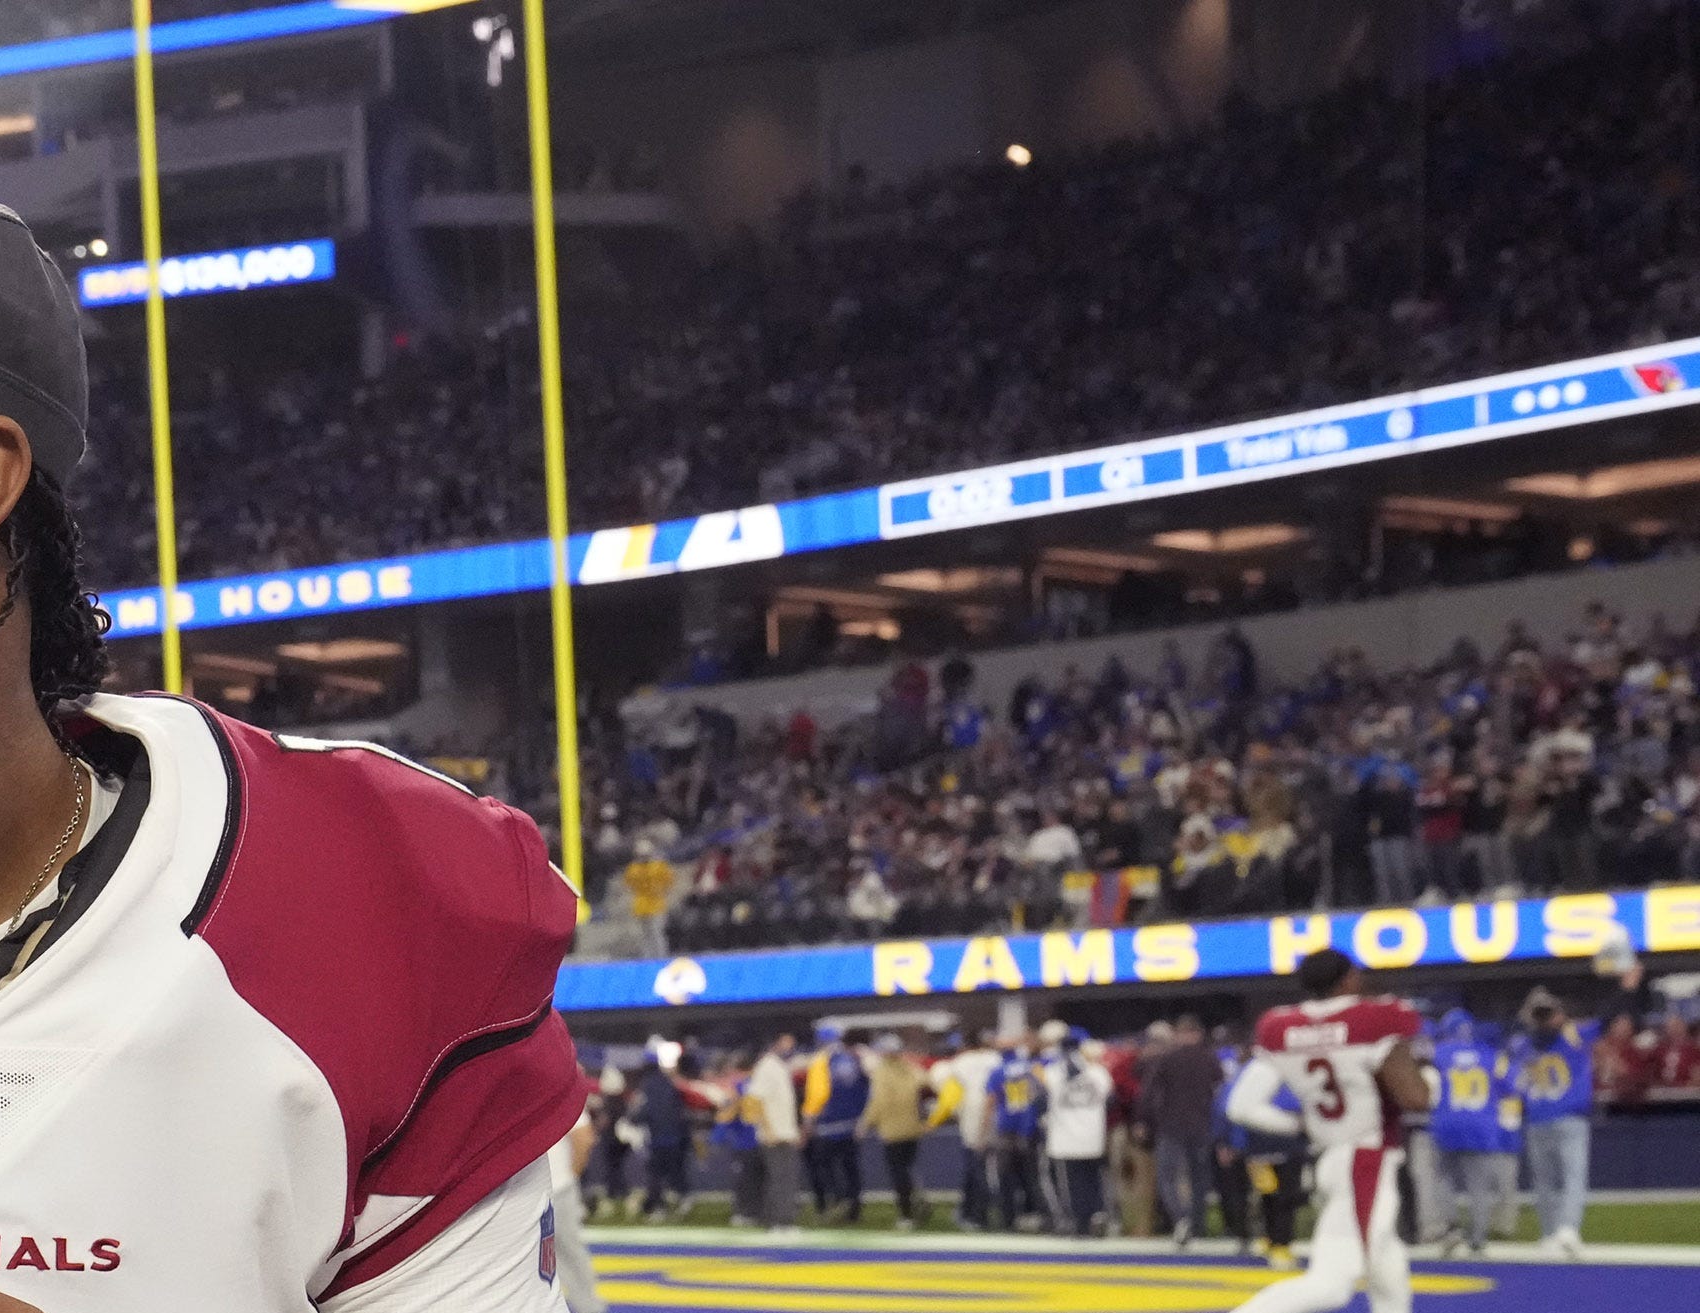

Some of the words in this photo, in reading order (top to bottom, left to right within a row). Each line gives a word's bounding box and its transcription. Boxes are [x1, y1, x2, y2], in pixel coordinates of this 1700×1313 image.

[219, 565, 412, 617] HOUSE
[872, 923, 1199, 997] RAMS
[1269, 885, 1700, 975] HOUSE
[1306, 1057, 1347, 1121] 3
